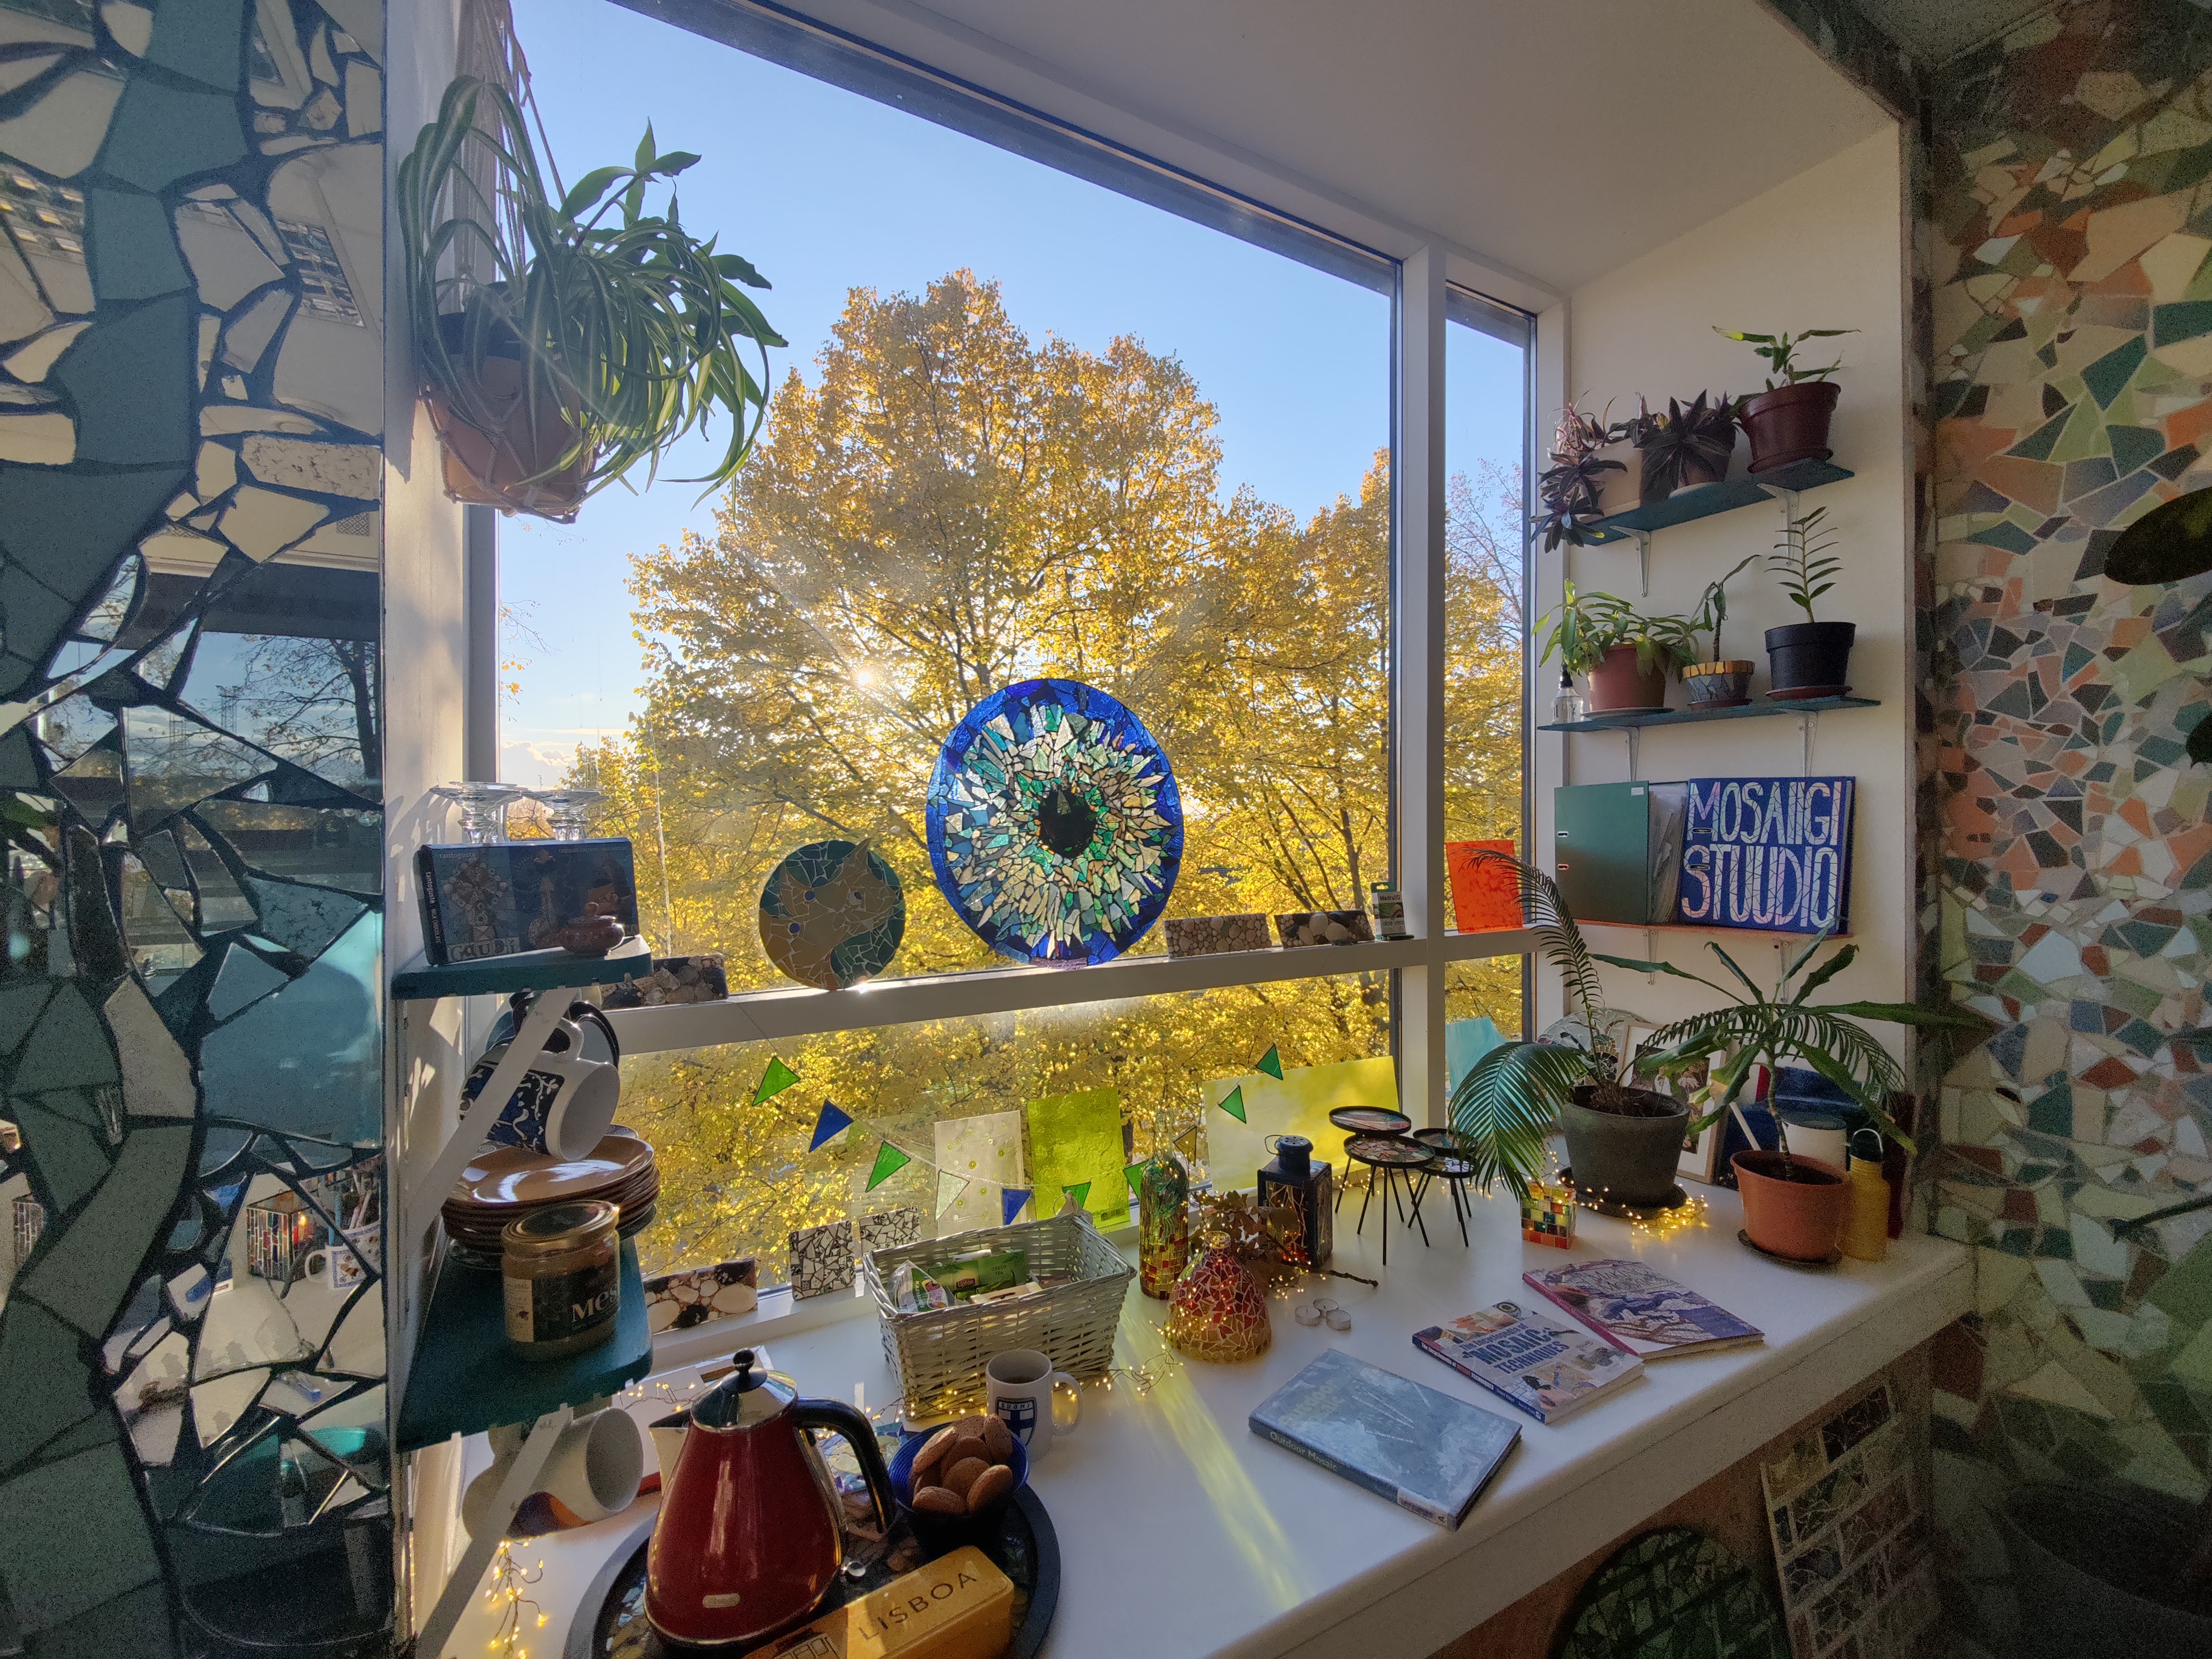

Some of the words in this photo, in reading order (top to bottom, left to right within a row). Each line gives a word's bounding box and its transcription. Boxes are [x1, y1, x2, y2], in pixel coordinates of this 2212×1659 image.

[1687, 781, 1842, 846] MOSAIIGI
[1681, 844, 1838, 928] STUUDIO
[957, 1279, 974, 1288] Lipton
[1459, 1340, 1477, 1351] The
[1473, 1326, 1521, 1346] Encyclopedia
[1468, 1328, 1552, 1365] MOSAIC
[1493, 1341, 1570, 1374] TECHNIQUES
[1000, 1402, 1030, 1411] SUOMI
[1270, 1431, 1306, 1455] Outdoor
[1308, 1449, 1338, 1472] Mosaic
[858, 1572, 977, 1641] LISBOA
